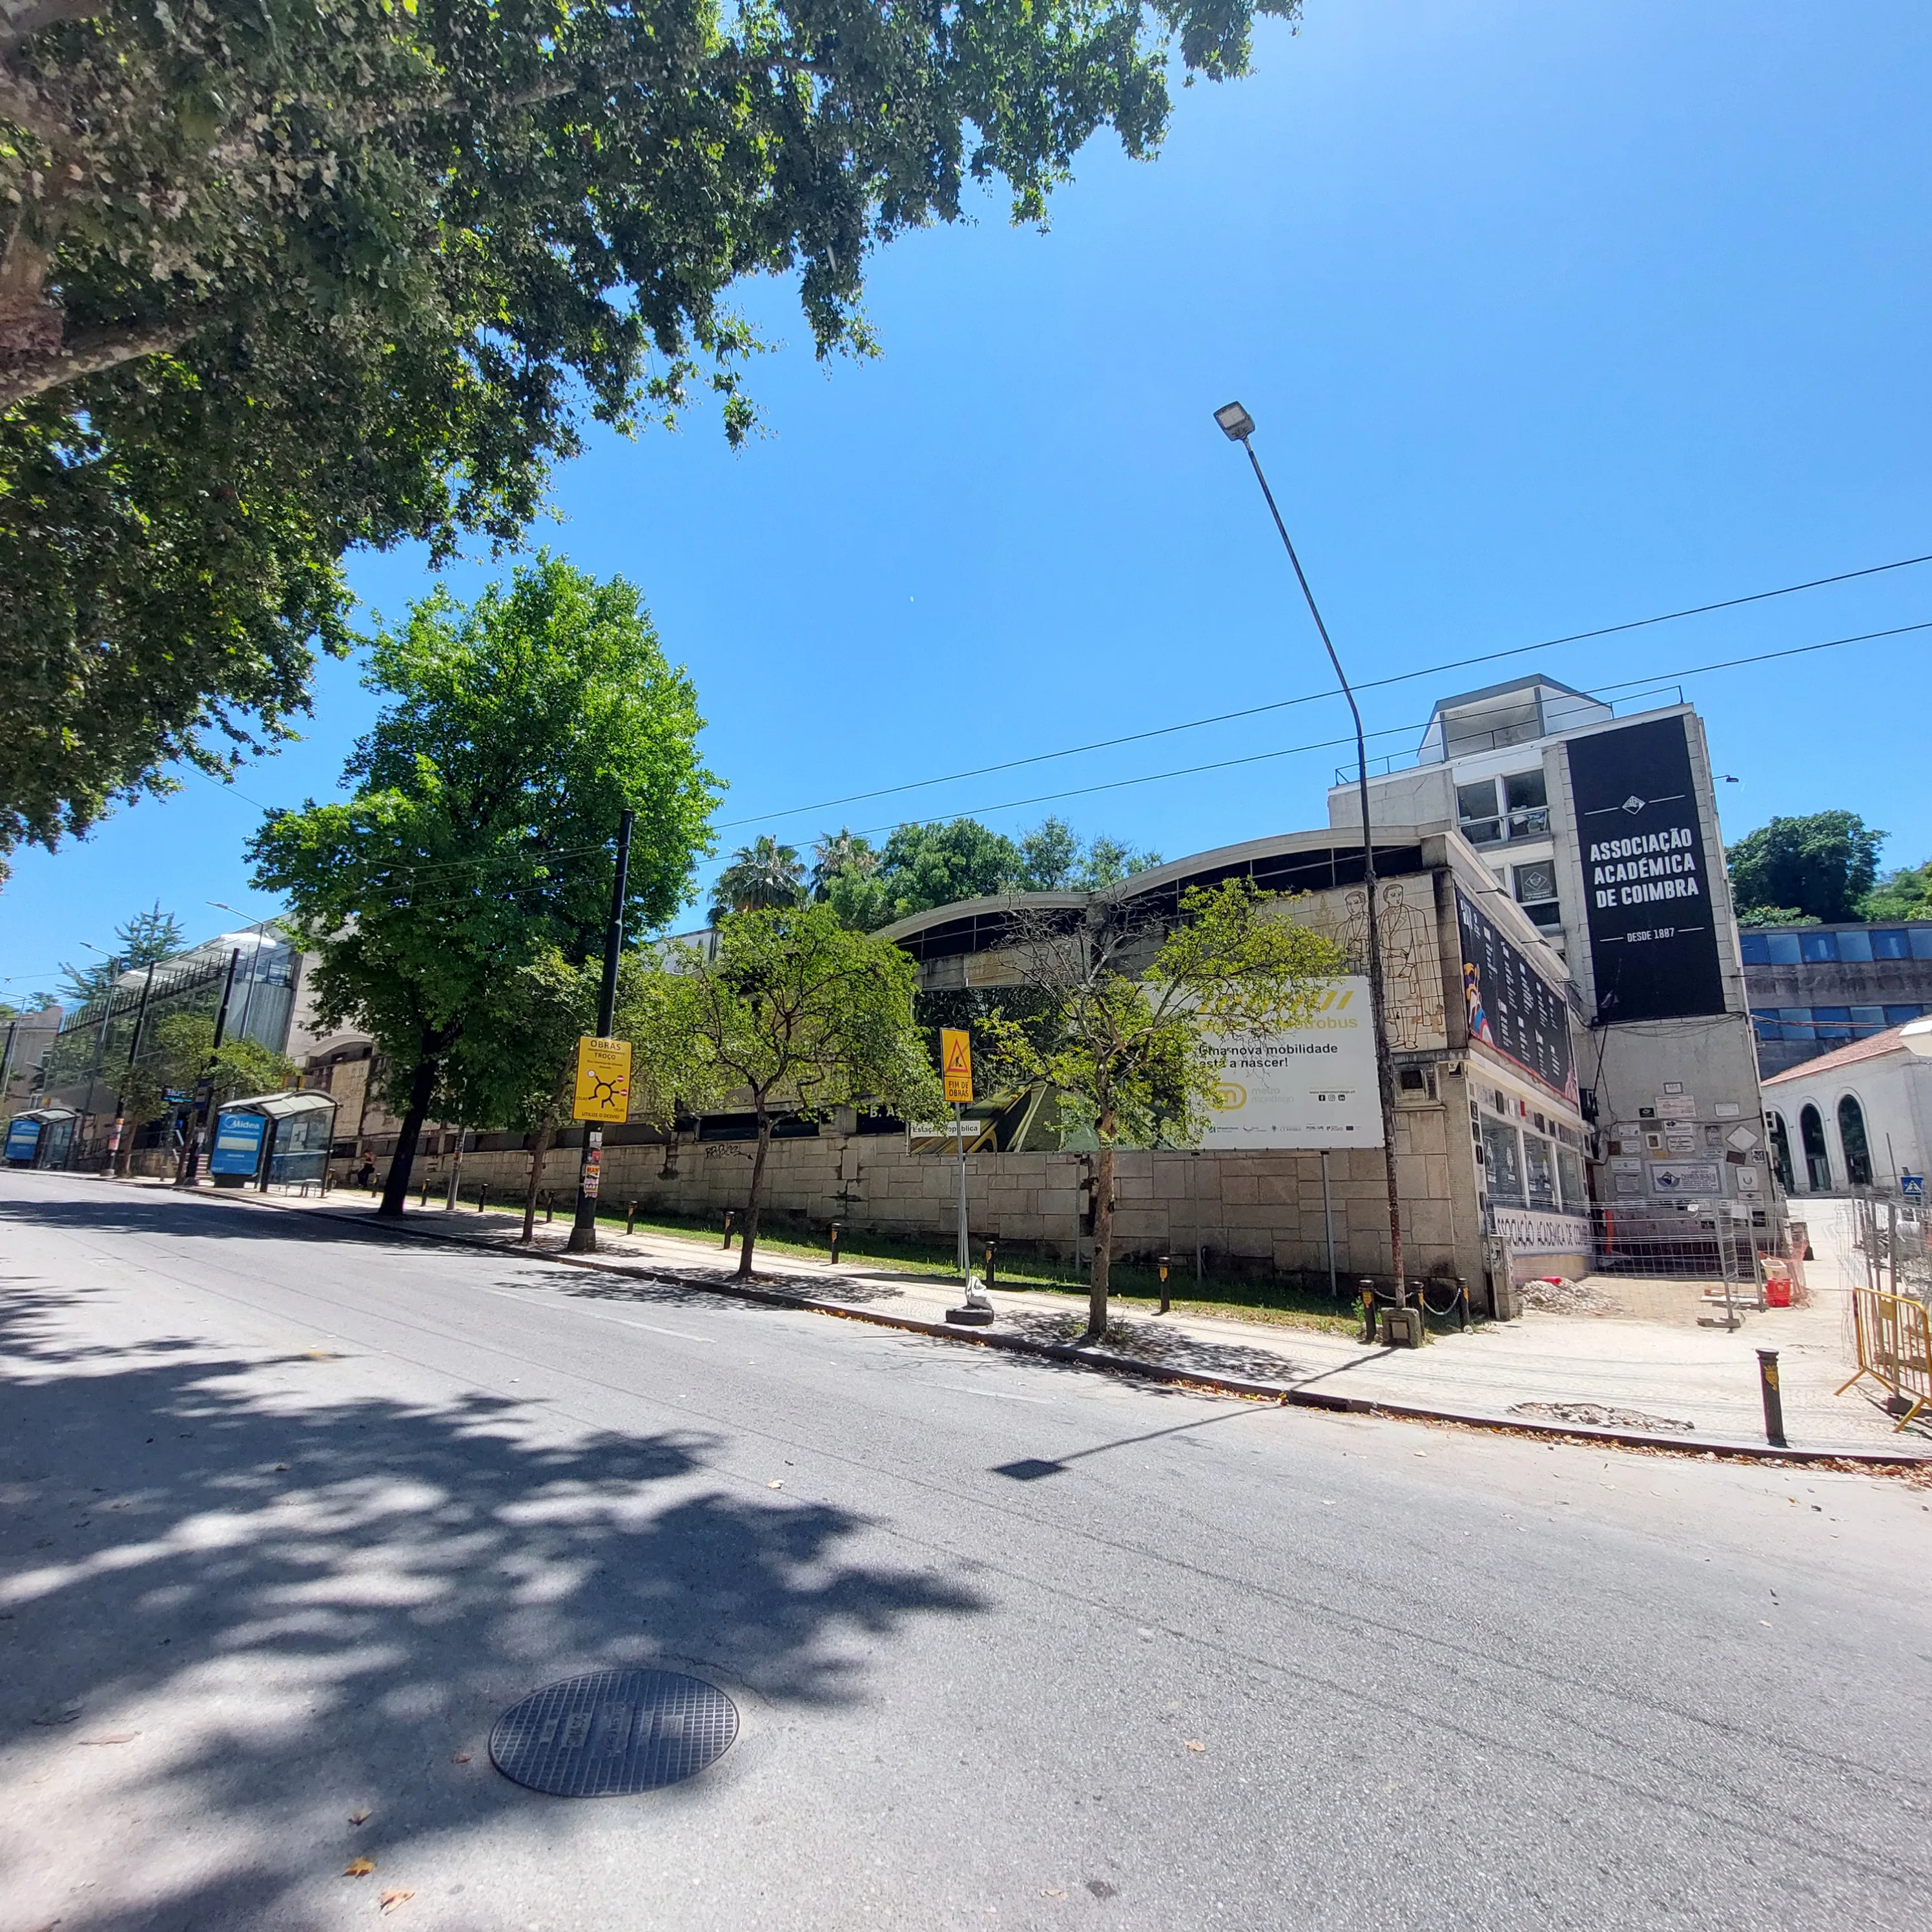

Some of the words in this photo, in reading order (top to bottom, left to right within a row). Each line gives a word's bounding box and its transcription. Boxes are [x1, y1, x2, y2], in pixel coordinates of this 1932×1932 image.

[1590, 828, 1692, 862] ASSOCIAÇÃO
[1594, 852, 1696, 885] ACADÉMICA
[1596, 889, 1618, 909] DE
[1621, 877, 1699, 905] COIMBRA
[1627, 930, 1652, 943] DESDE
[1653, 927, 1674, 940] 1887
[590, 1040, 621, 1051] OBRAS
[1231, 1046, 1262, 1056] nova
[1266, 1043, 1338, 1054] mobilidade
[1240, 1057, 1288, 1068] nascer!
[231, 1120, 260, 1129] Midea
[912, 1125, 940, 1134] Estaç
